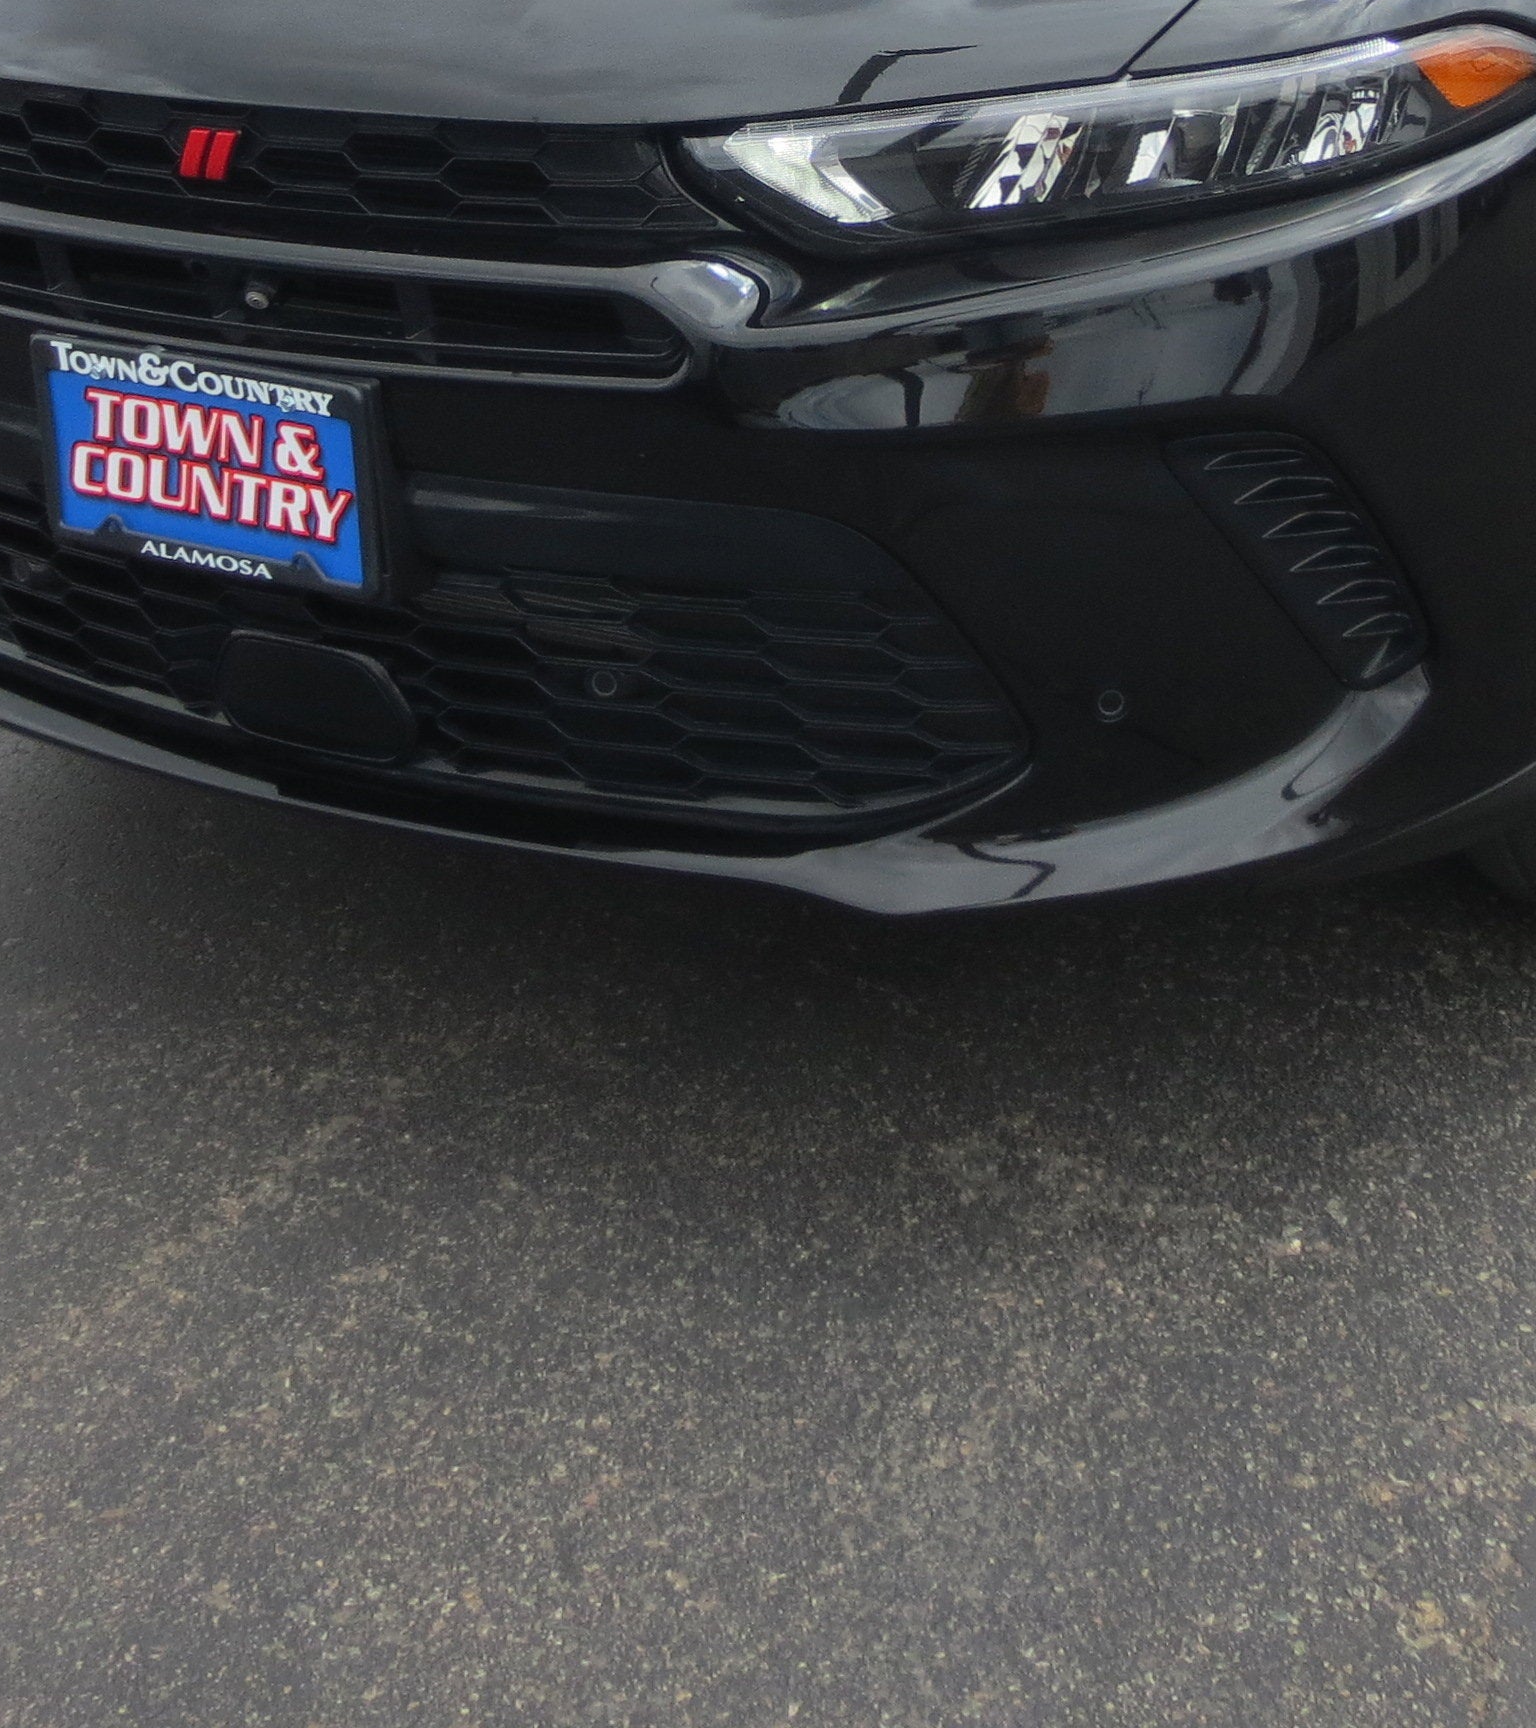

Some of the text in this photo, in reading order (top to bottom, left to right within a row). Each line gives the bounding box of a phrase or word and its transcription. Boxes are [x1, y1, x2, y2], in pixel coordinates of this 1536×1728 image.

[85, 387, 324, 480] TOWN &
[71, 442, 353, 543] COUNTRY
[140, 540, 274, 581] ALAMOSA
